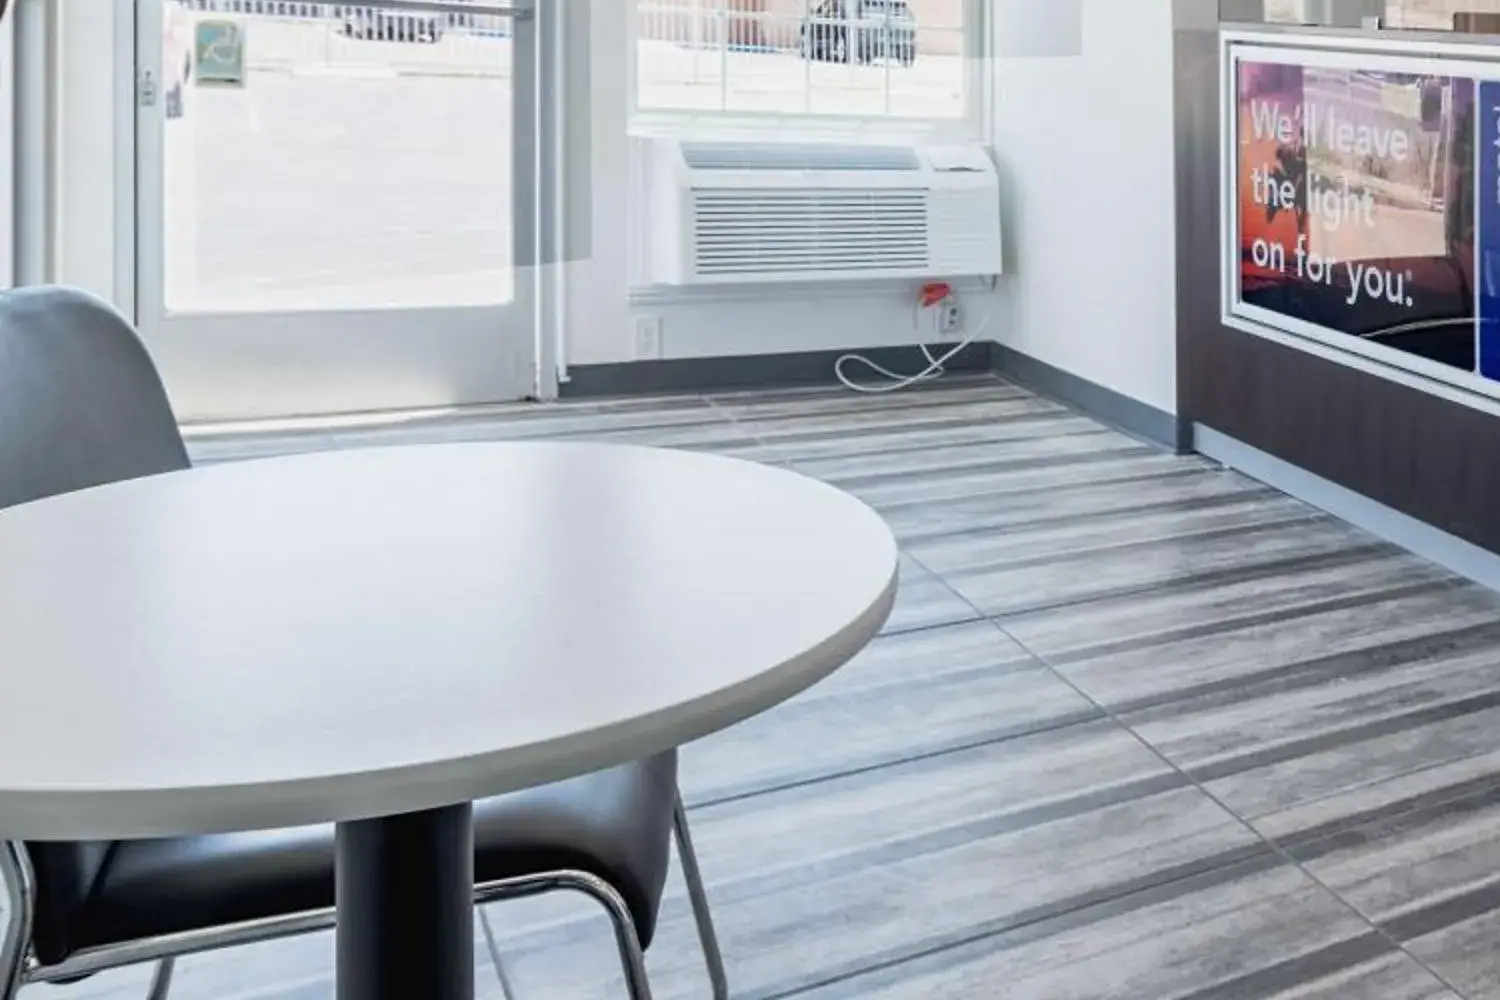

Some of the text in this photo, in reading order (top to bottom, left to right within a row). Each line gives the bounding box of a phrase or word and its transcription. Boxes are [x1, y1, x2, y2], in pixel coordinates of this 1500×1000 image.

[1251, 99, 1408, 161] We'll leave
[1251, 163, 1376, 232] the light
[1252, 236, 1285, 274] on
[1294, 233, 1336, 286] for
